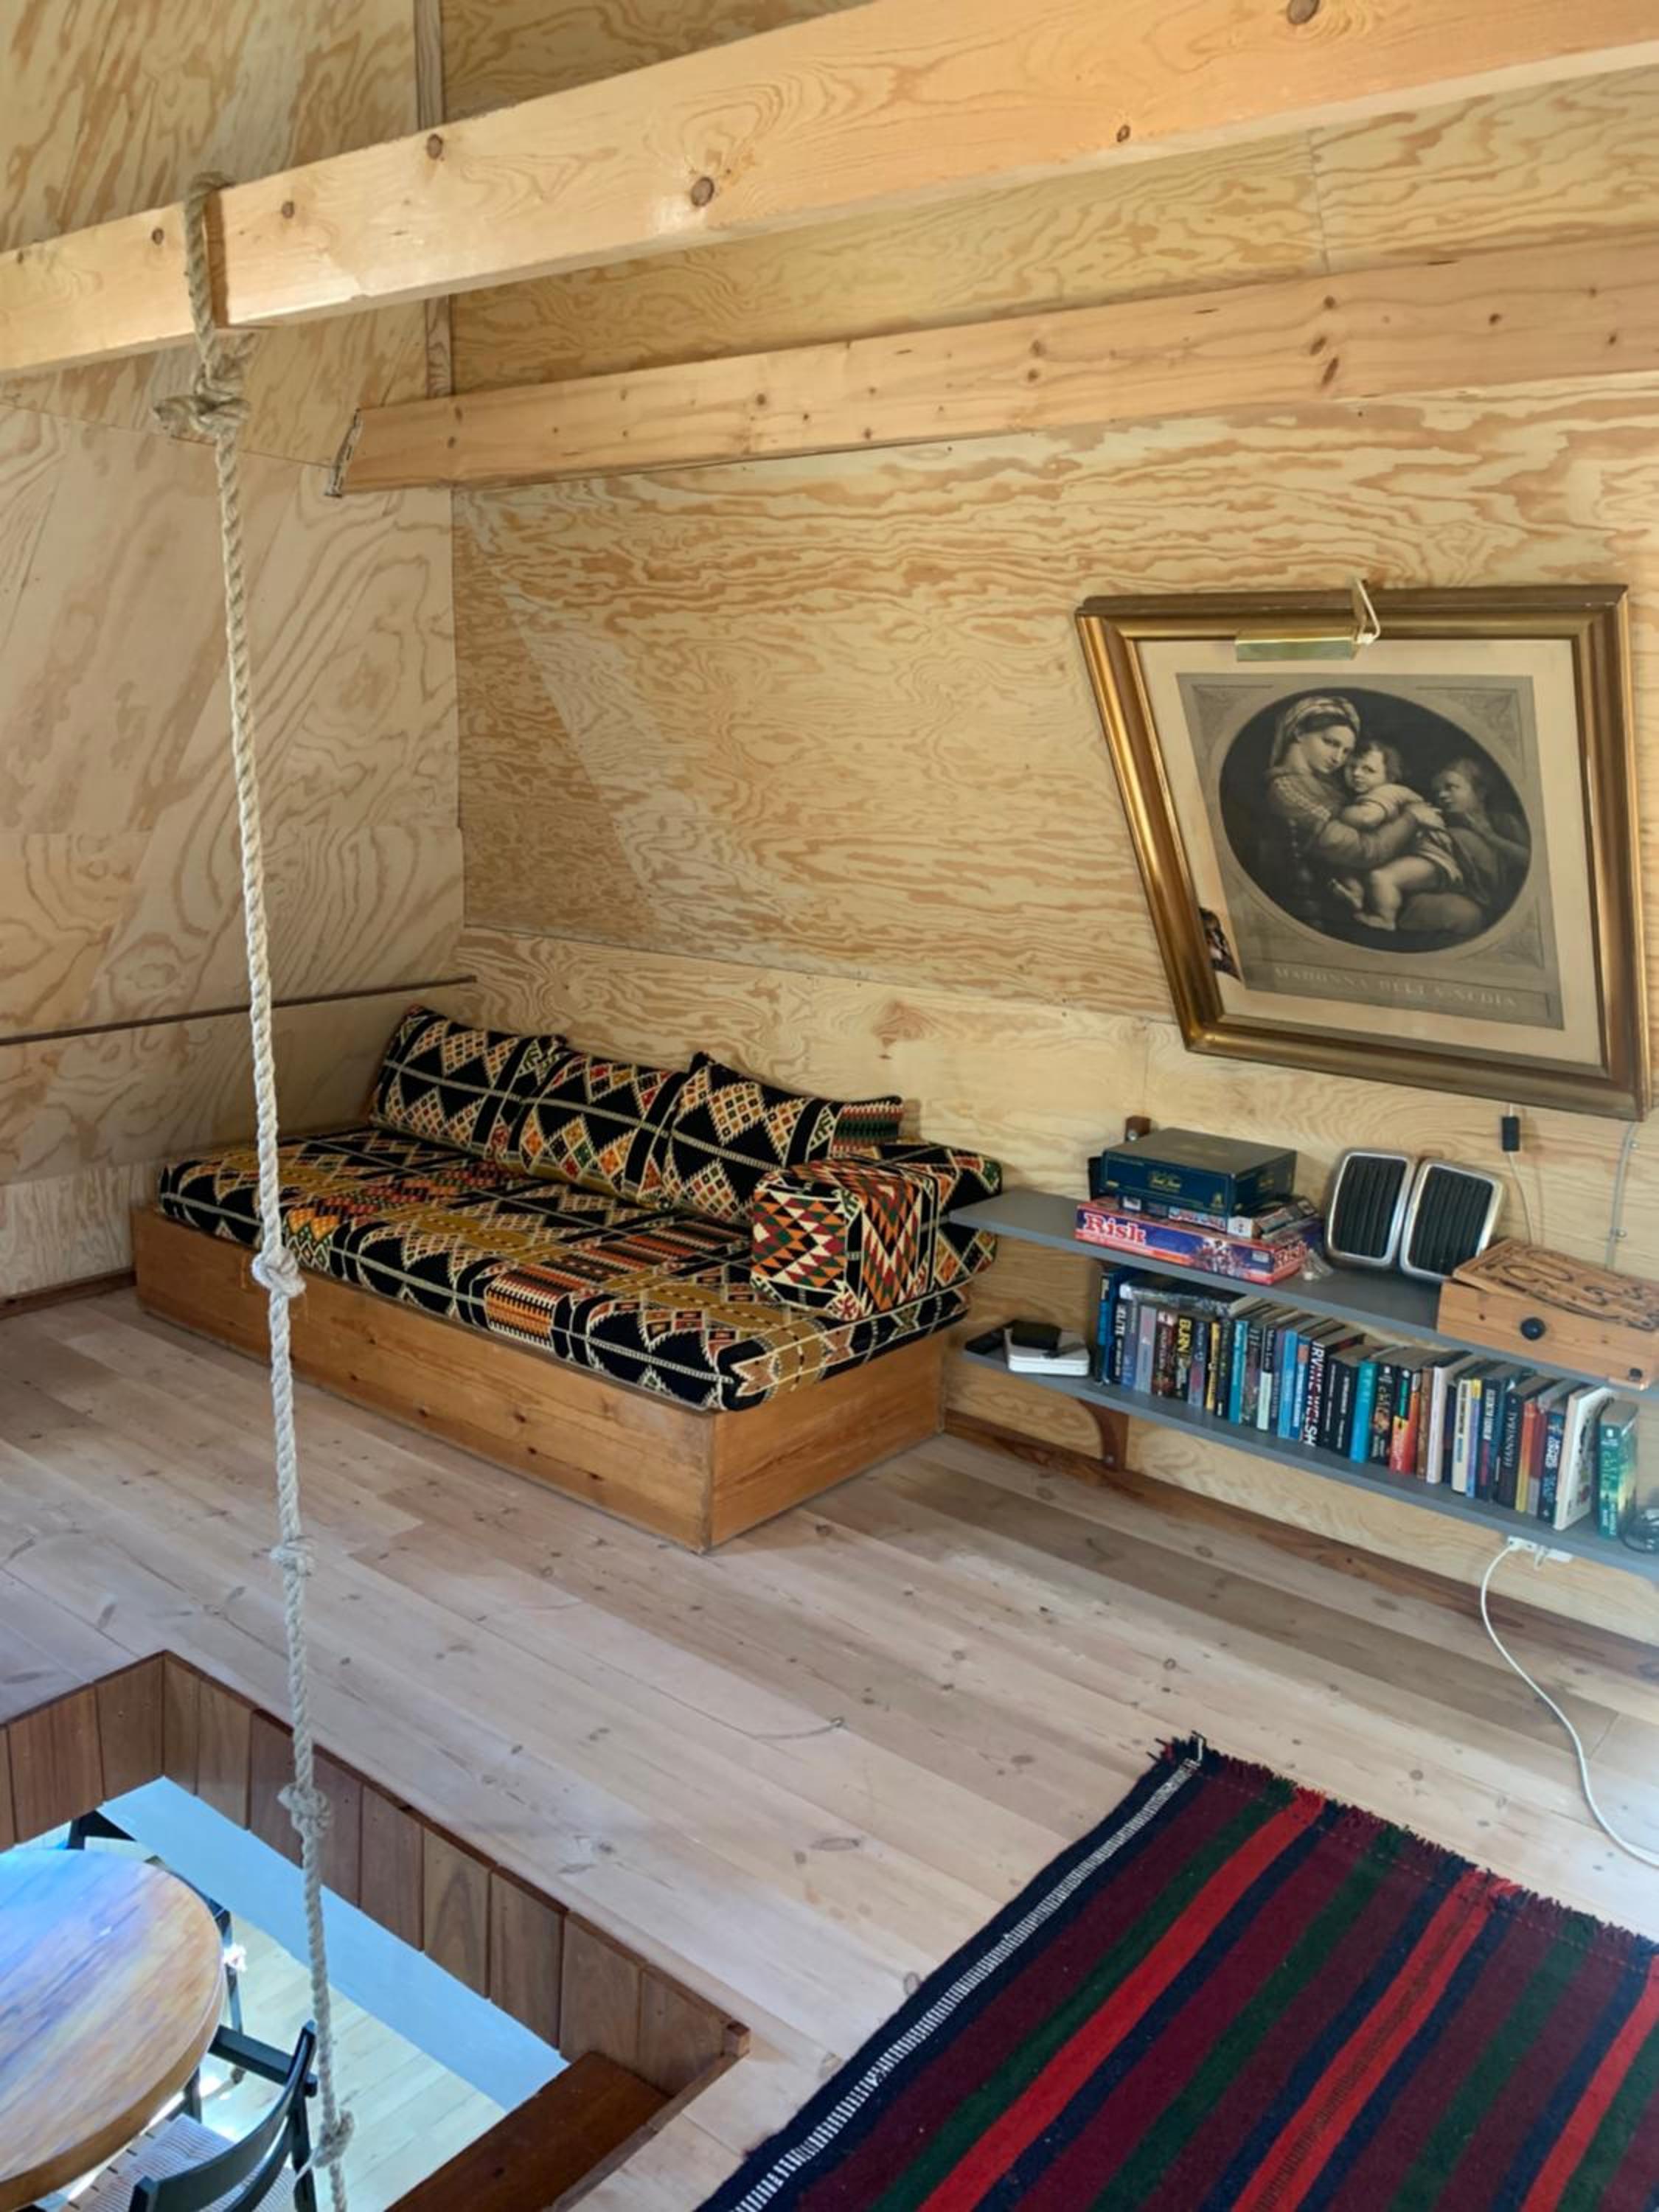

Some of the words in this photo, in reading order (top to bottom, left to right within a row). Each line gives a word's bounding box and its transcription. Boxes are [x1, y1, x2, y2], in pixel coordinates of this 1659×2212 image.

[1275, 967, 1369, 990] MADONNA
[1083, 1213, 1147, 1244] Risk
[1308, 1340, 1326, 1391] IRVINE
[1303, 1394, 1322, 1447] WELSH
